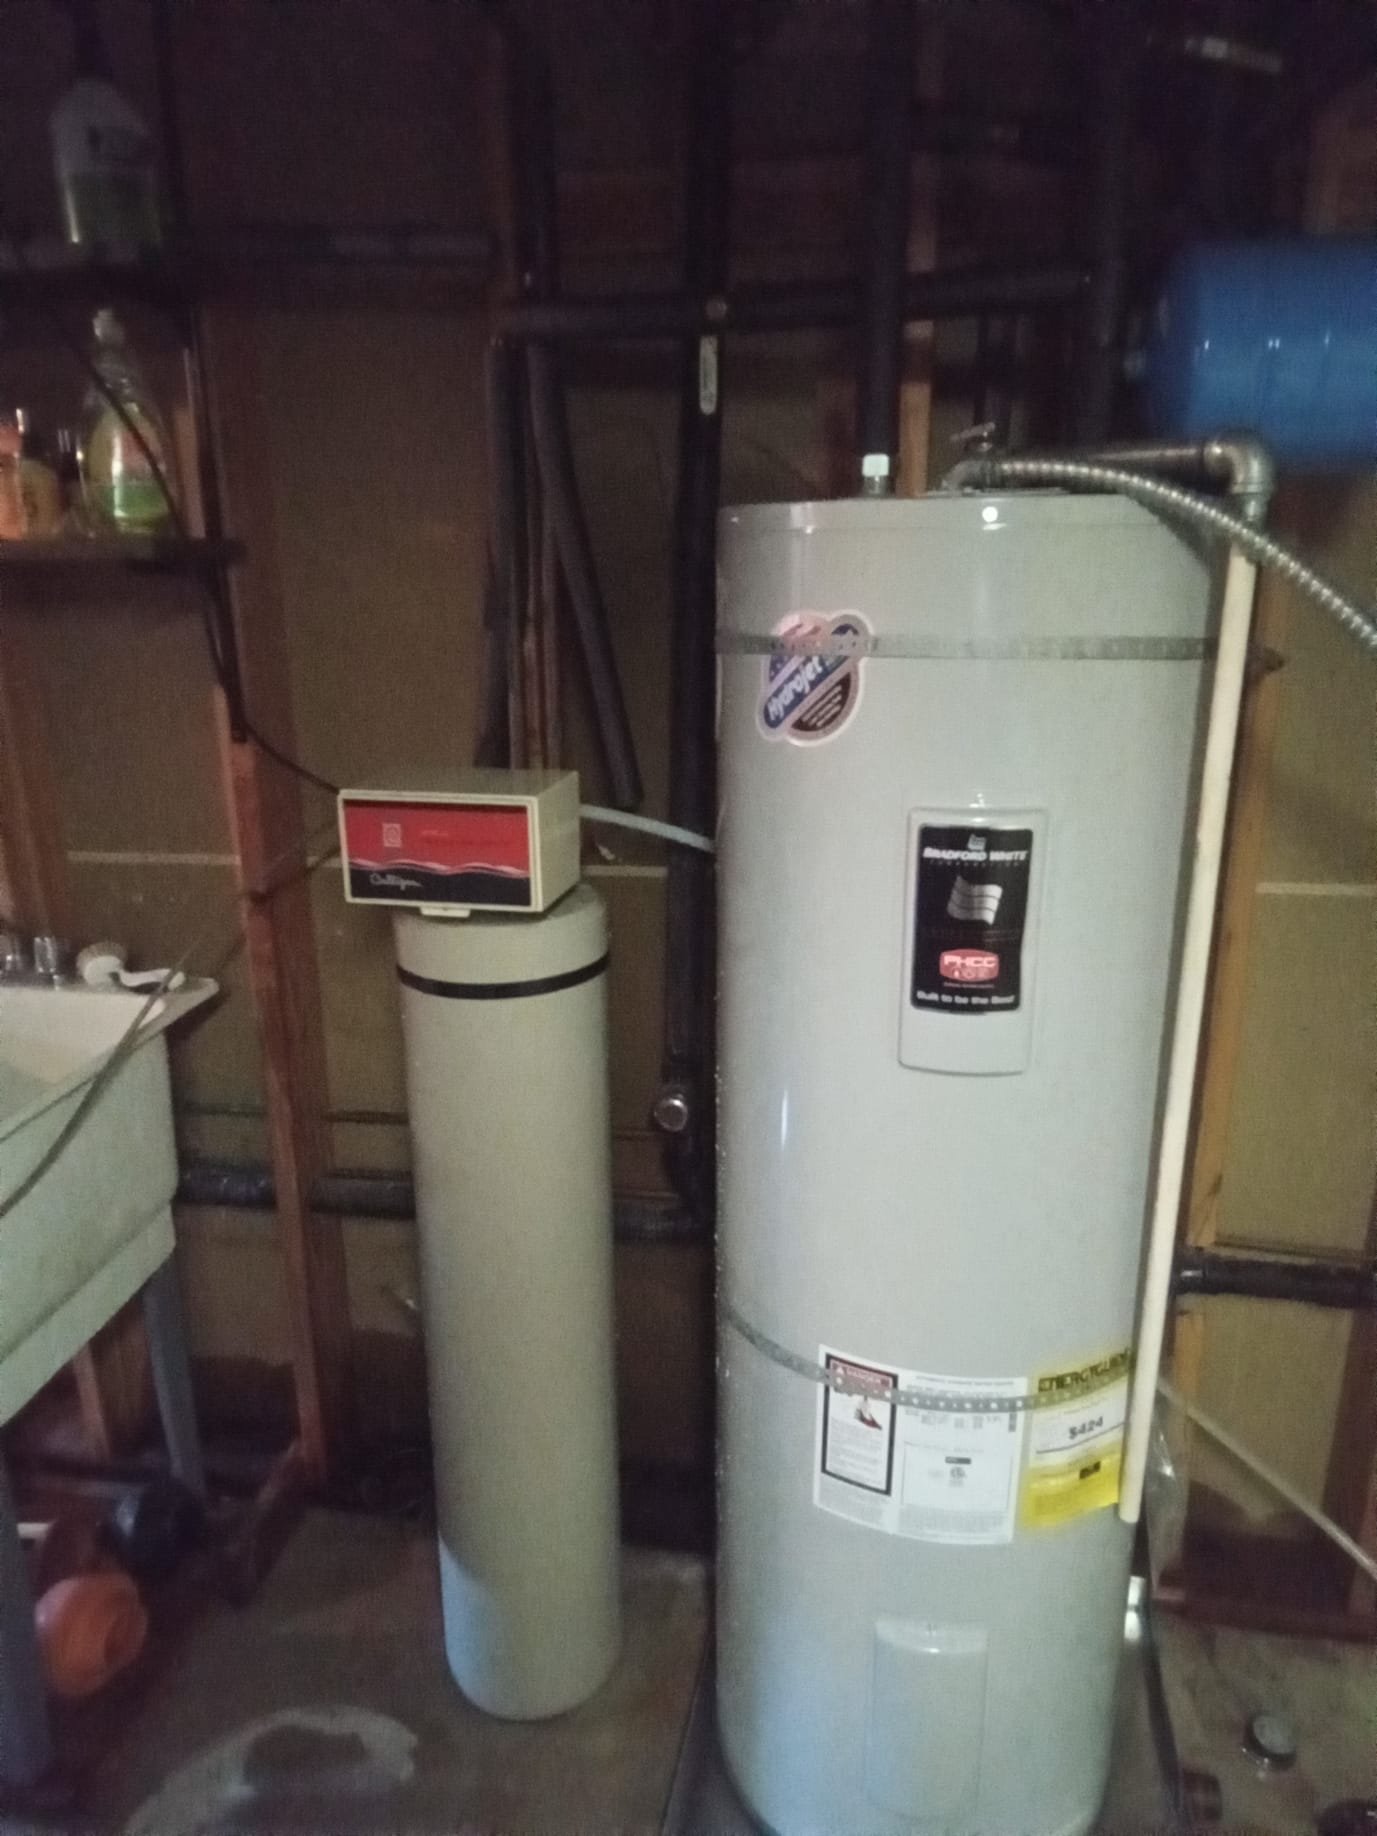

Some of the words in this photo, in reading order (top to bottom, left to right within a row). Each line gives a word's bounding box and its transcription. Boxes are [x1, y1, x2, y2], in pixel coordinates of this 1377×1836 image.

[922, 846, 987, 861] BRADFORD
[988, 849, 1029, 861] WHITE
[943, 955, 996, 968] PHCC
[940, 993, 953, 1003] to
[954, 994, 969, 1004] be
[971, 996, 989, 1005] the
